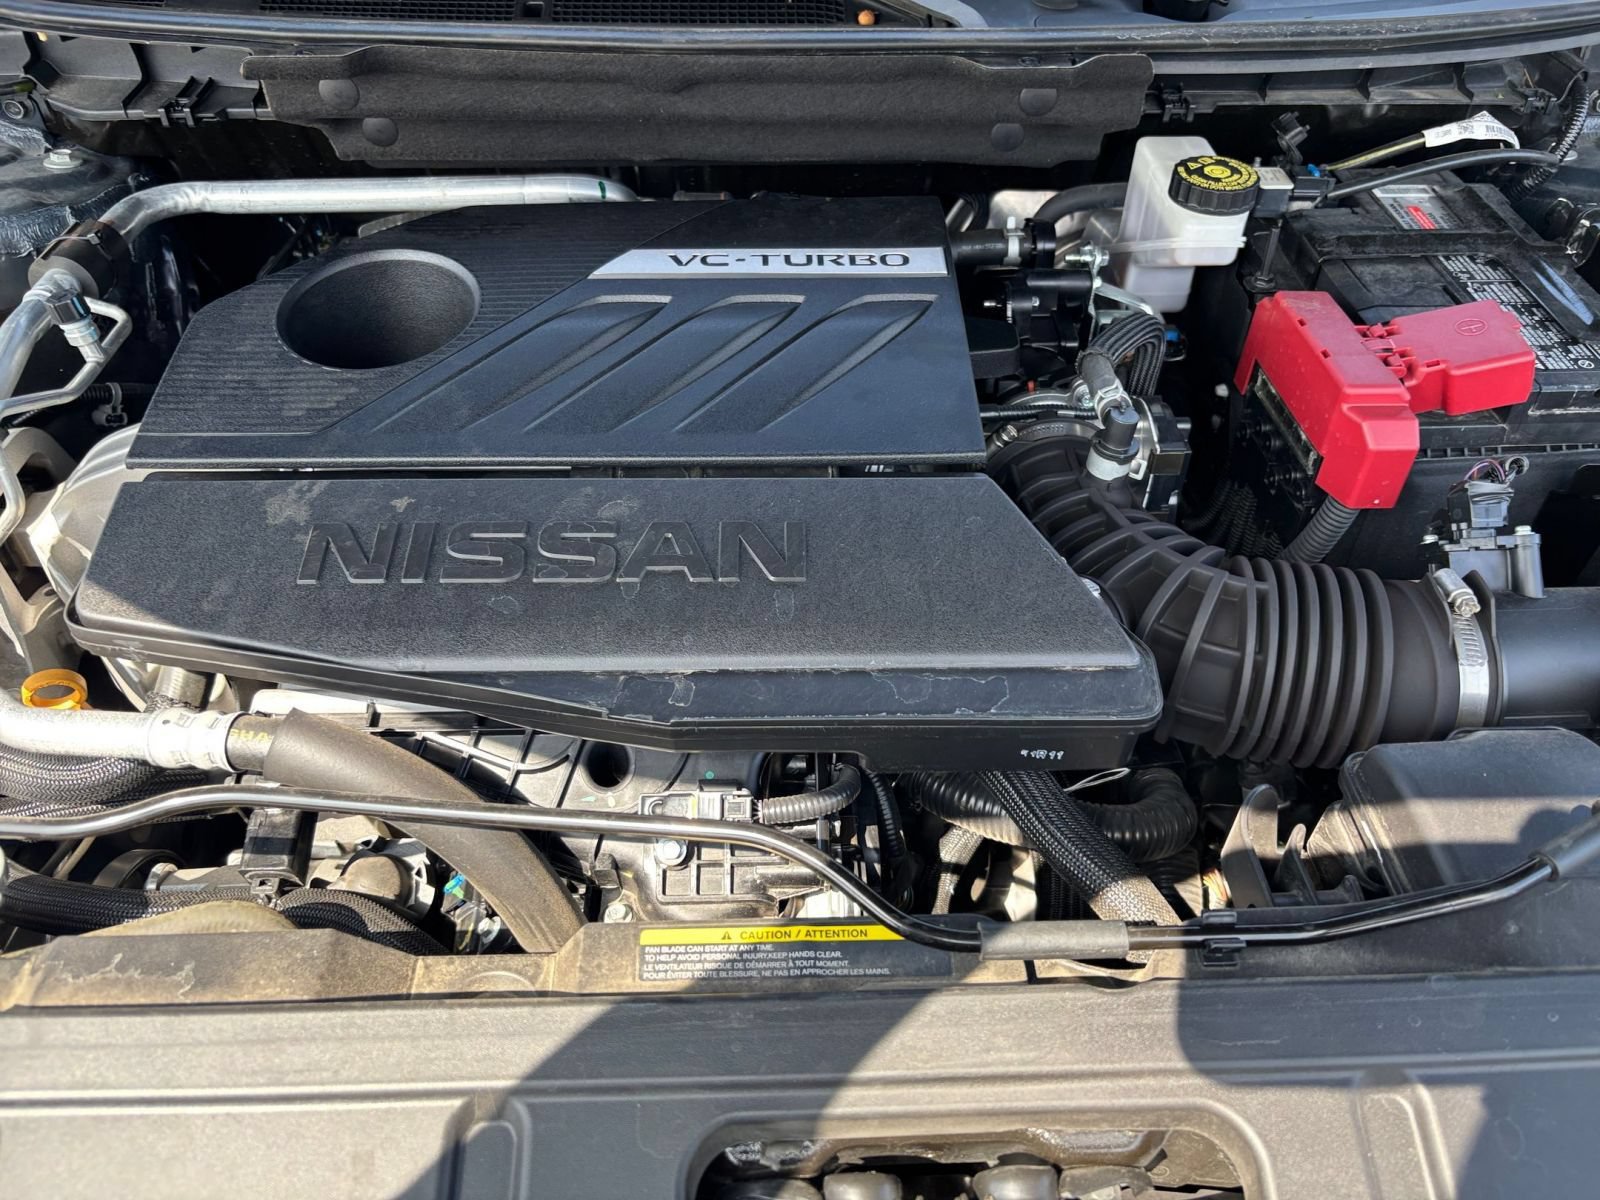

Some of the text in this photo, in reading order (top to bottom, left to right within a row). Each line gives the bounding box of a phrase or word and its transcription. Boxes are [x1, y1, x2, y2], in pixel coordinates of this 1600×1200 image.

[667, 253, 910, 267] VC-TURBO
[297, 521, 806, 583] NISSAN
[740, 929, 868, 940] CAUTION / ATTENTION
[729, 944, 738, 952] AT
[645, 954, 655, 962] TO
[657, 954, 676, 962] HELP
[677, 953, 700, 961] AVOID
[702, 952, 741, 960] PERSONAL
[644, 963, 653, 971] LE
[655, 962, 703, 971] VENTILATEUR
[704, 962, 732, 970] RISQUE
[746, 960, 787, 969] DÉMARRER
[788, 959, 794, 968] À
[643, 971, 666, 979] POUR
[667, 969, 692, 979] ÉVITER
[694, 970, 718, 978] TOUTE
[762, 969, 772, 977] NE
[791, 968, 800, 976] EN
[801, 968, 849, 976] APPROCHER
